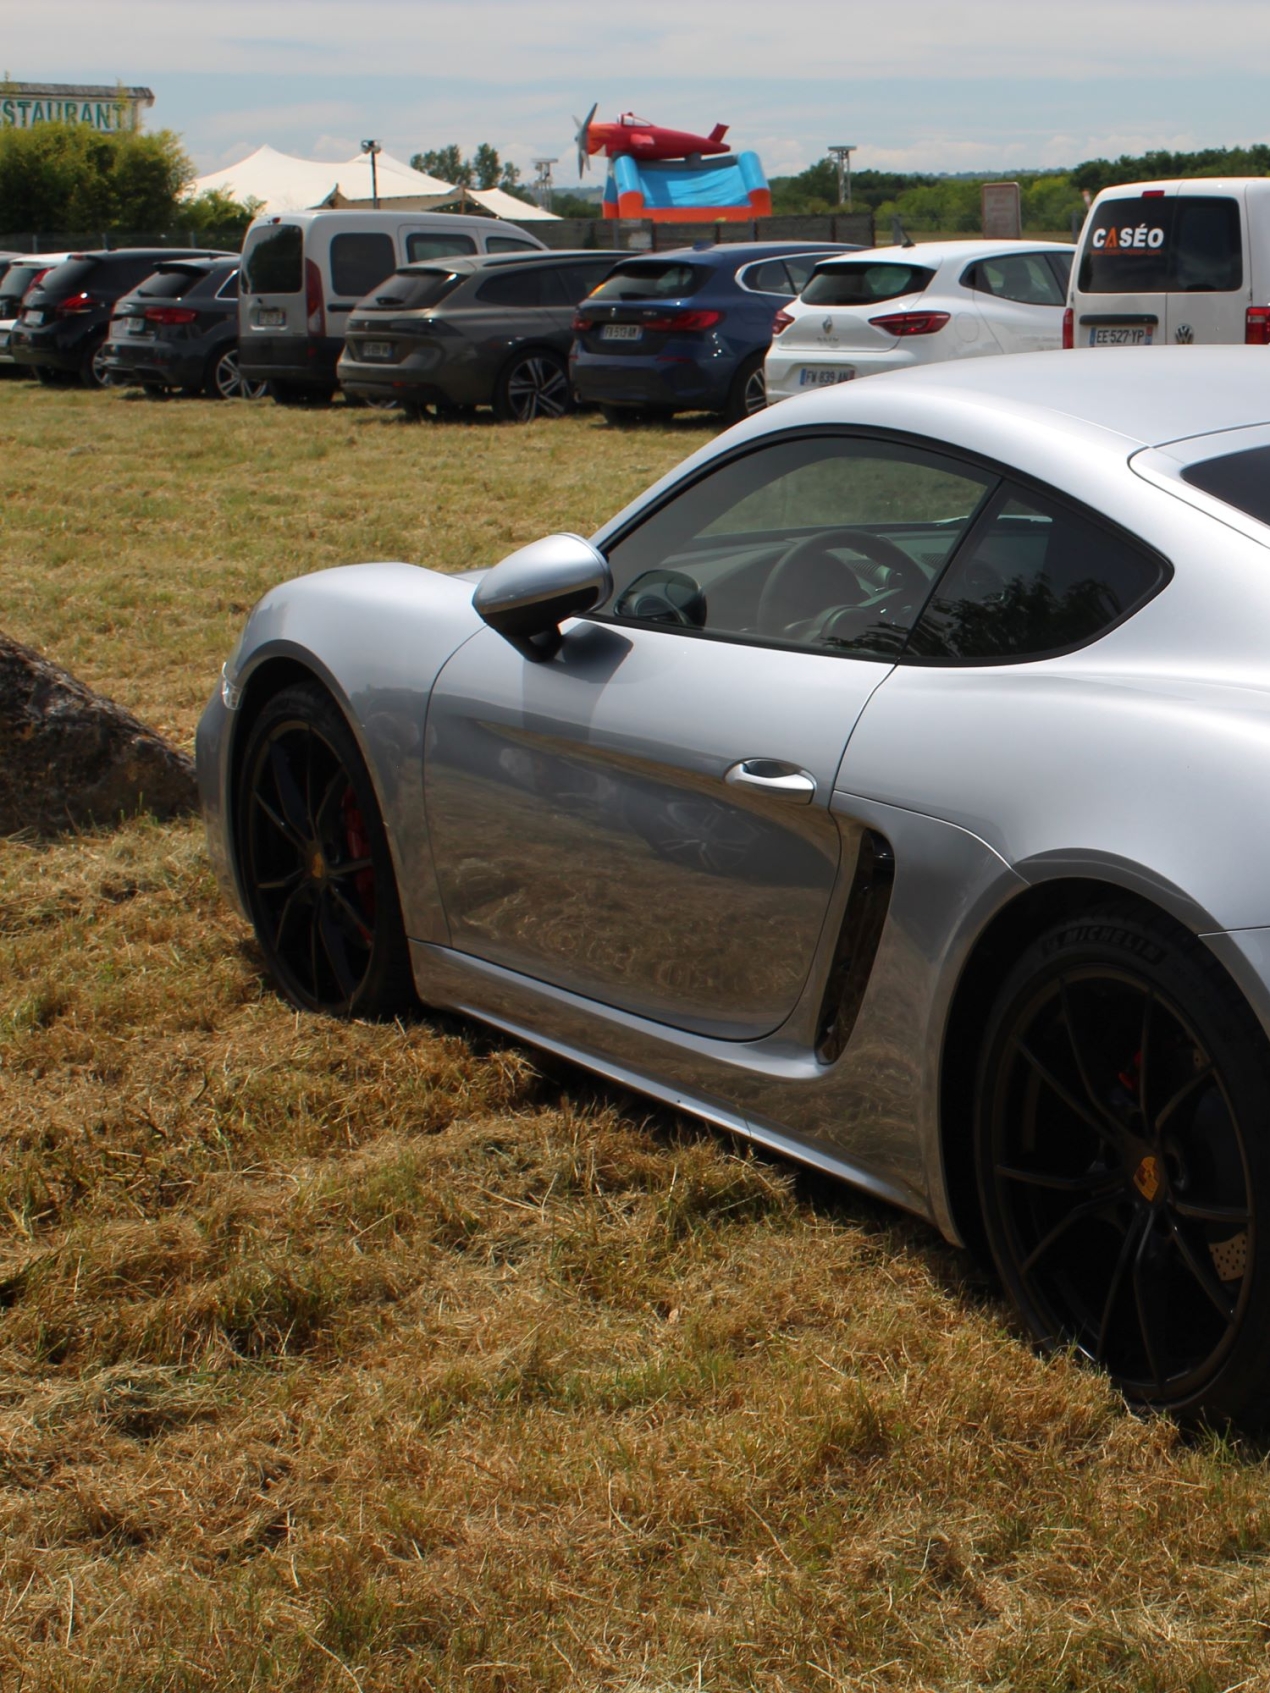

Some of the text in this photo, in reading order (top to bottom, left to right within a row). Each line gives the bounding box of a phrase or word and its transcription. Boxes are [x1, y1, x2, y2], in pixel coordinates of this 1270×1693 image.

[0, 100, 126, 129] STAURANT
[1093, 223, 1165, 248] CASÉO
[1064, 925, 1161, 961] MICHELIN
